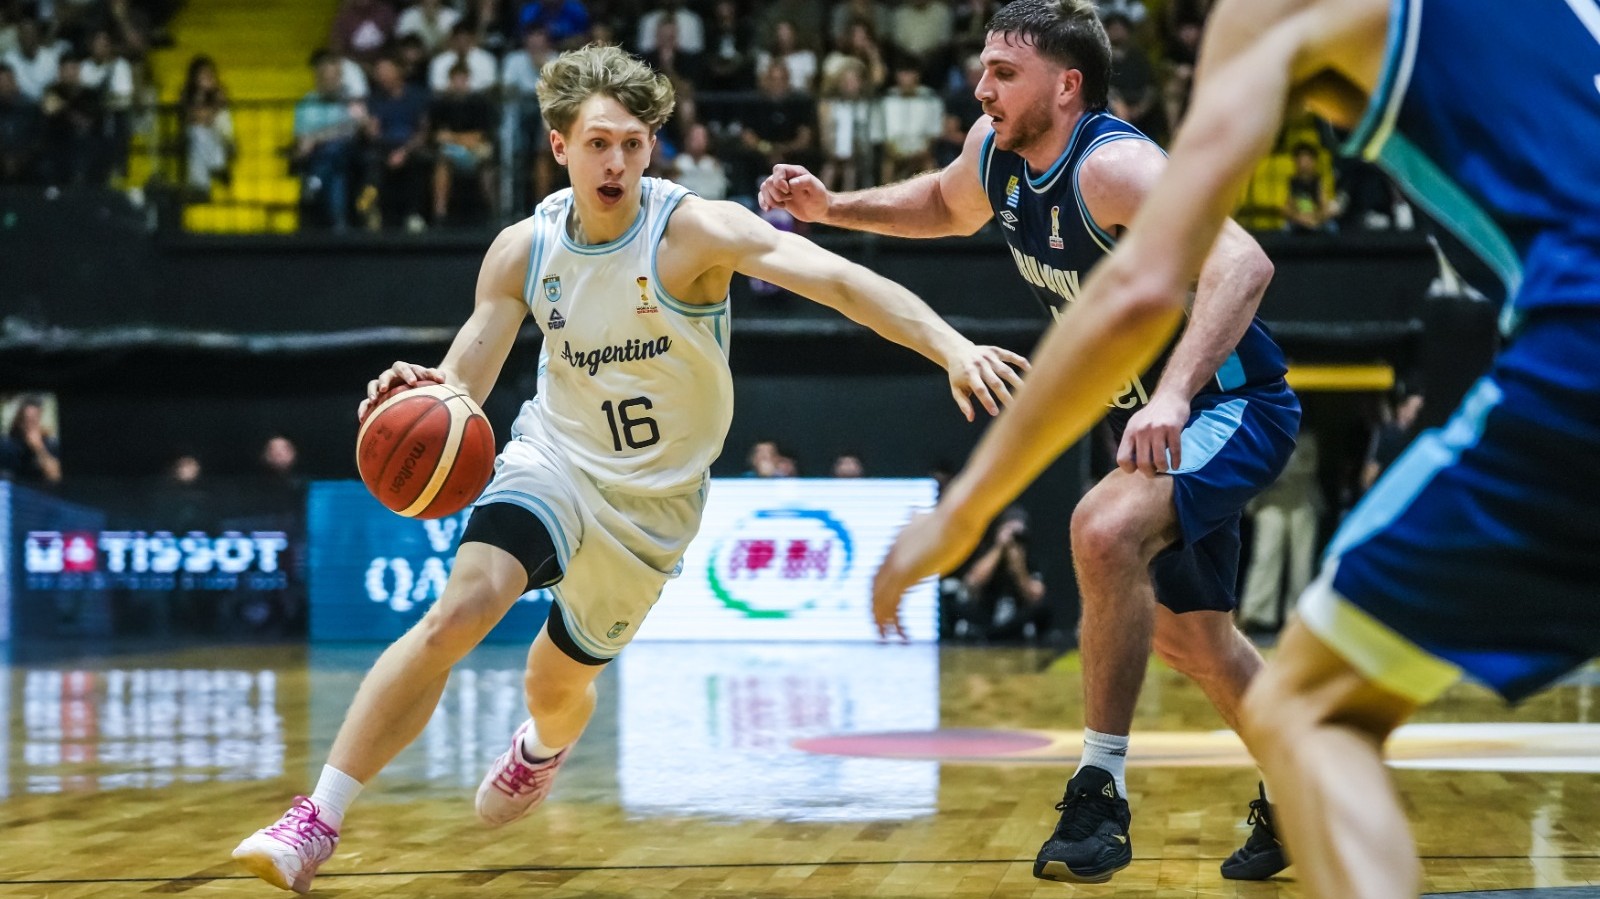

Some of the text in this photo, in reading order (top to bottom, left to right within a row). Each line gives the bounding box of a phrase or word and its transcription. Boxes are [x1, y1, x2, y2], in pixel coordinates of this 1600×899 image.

[560, 335, 672, 376] Argentina
[601, 396, 660, 451] 16
[390, 440, 426, 494] molten
[99, 531, 288, 573] TISSOT
